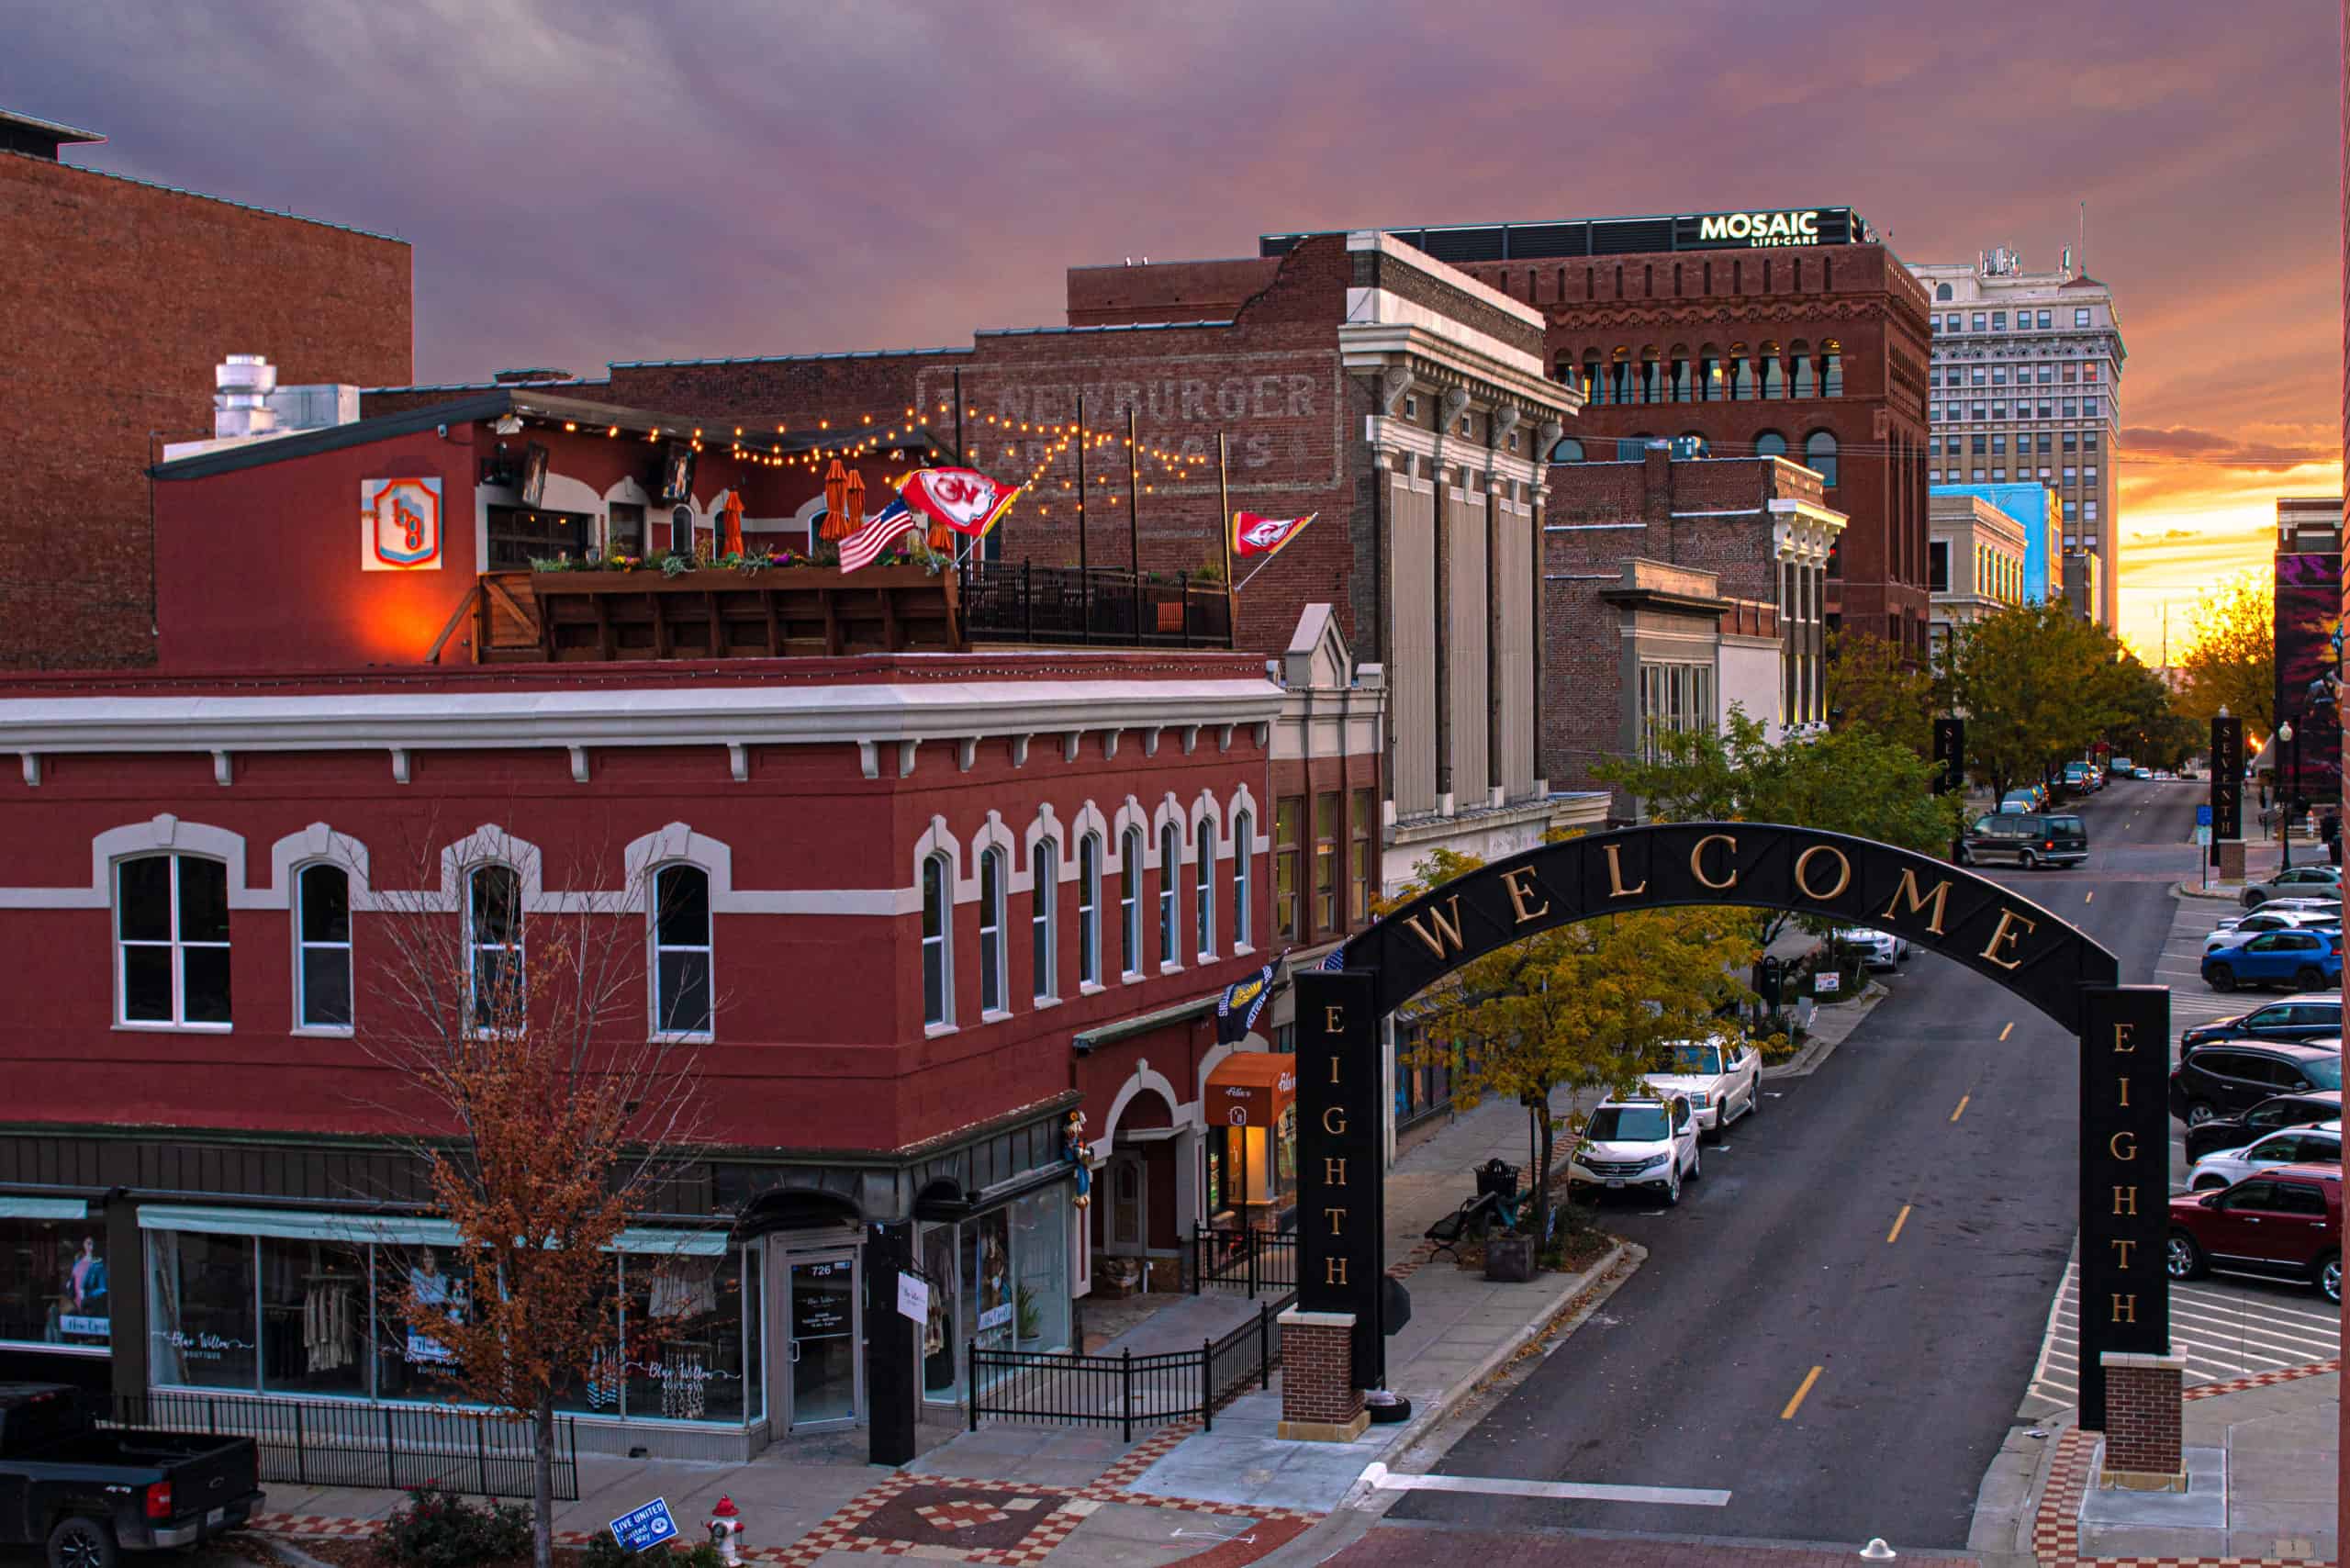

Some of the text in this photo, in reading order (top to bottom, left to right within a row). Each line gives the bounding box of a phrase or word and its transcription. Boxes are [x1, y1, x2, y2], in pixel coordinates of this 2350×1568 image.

[1700, 211, 1819, 241] MOSAIC
[2221, 726, 2232, 834] SEVENTH
[1402, 833, 2037, 971] WELCOME
[1322, 1006, 1348, 1285] EIGHTH
[2109, 1024, 2138, 1323] EIGHTH
[811, 1265, 831, 1278] 726
[613, 1501, 665, 1533] LIVE UNITED
[633, 1531, 651, 1545] Way
